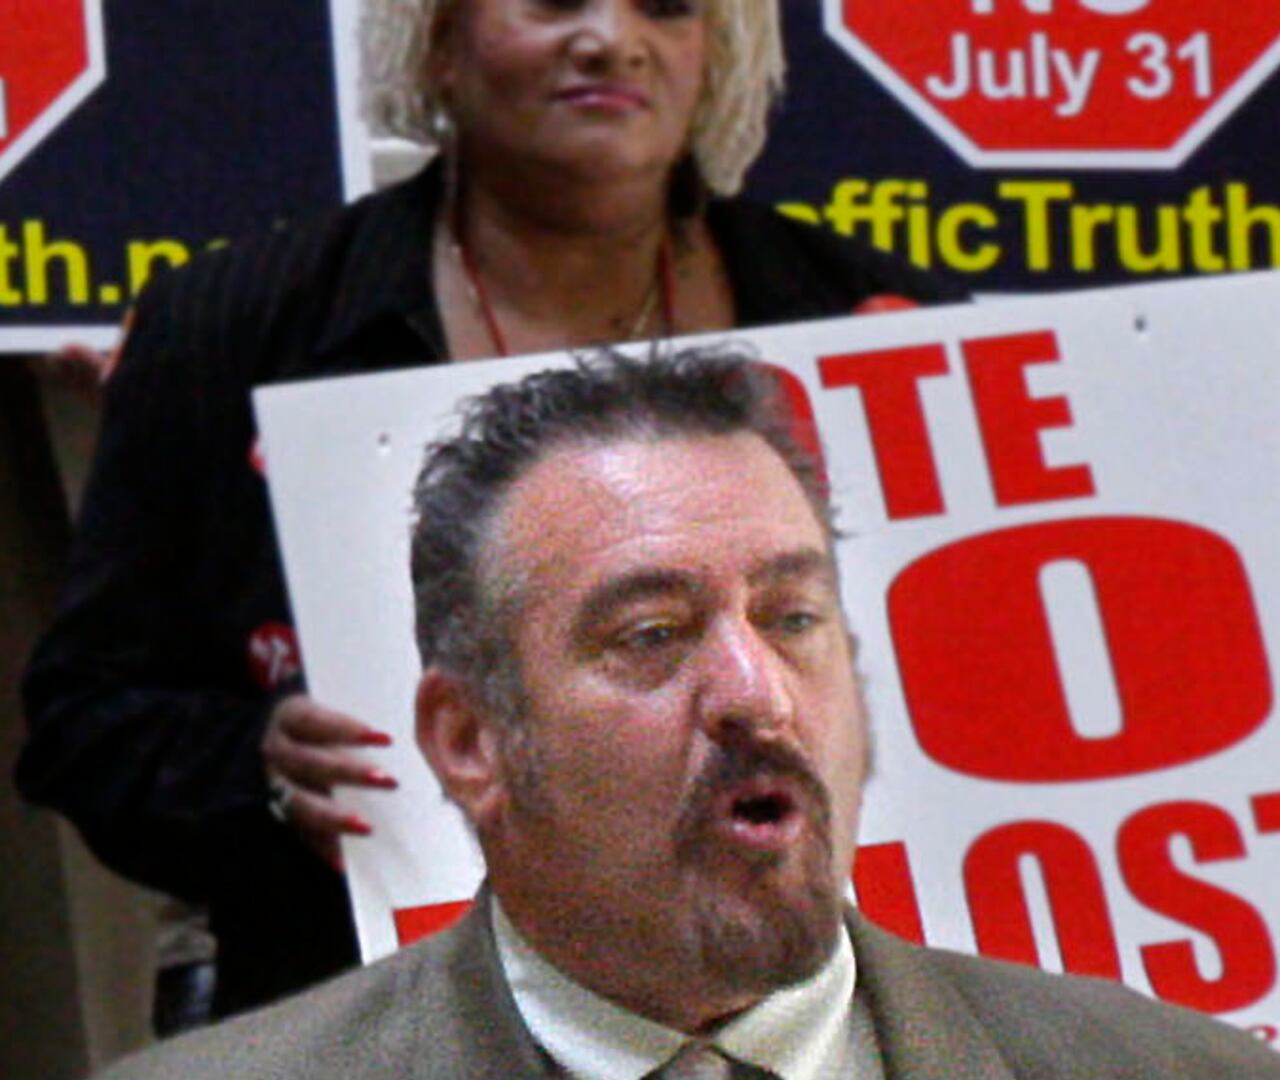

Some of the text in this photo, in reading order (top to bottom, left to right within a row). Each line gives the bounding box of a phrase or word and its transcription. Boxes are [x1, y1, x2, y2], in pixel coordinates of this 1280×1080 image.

[925, 32, 1211, 117] July 31
[752, 330, 1097, 522] TE
[886, 513, 1275, 784] O
